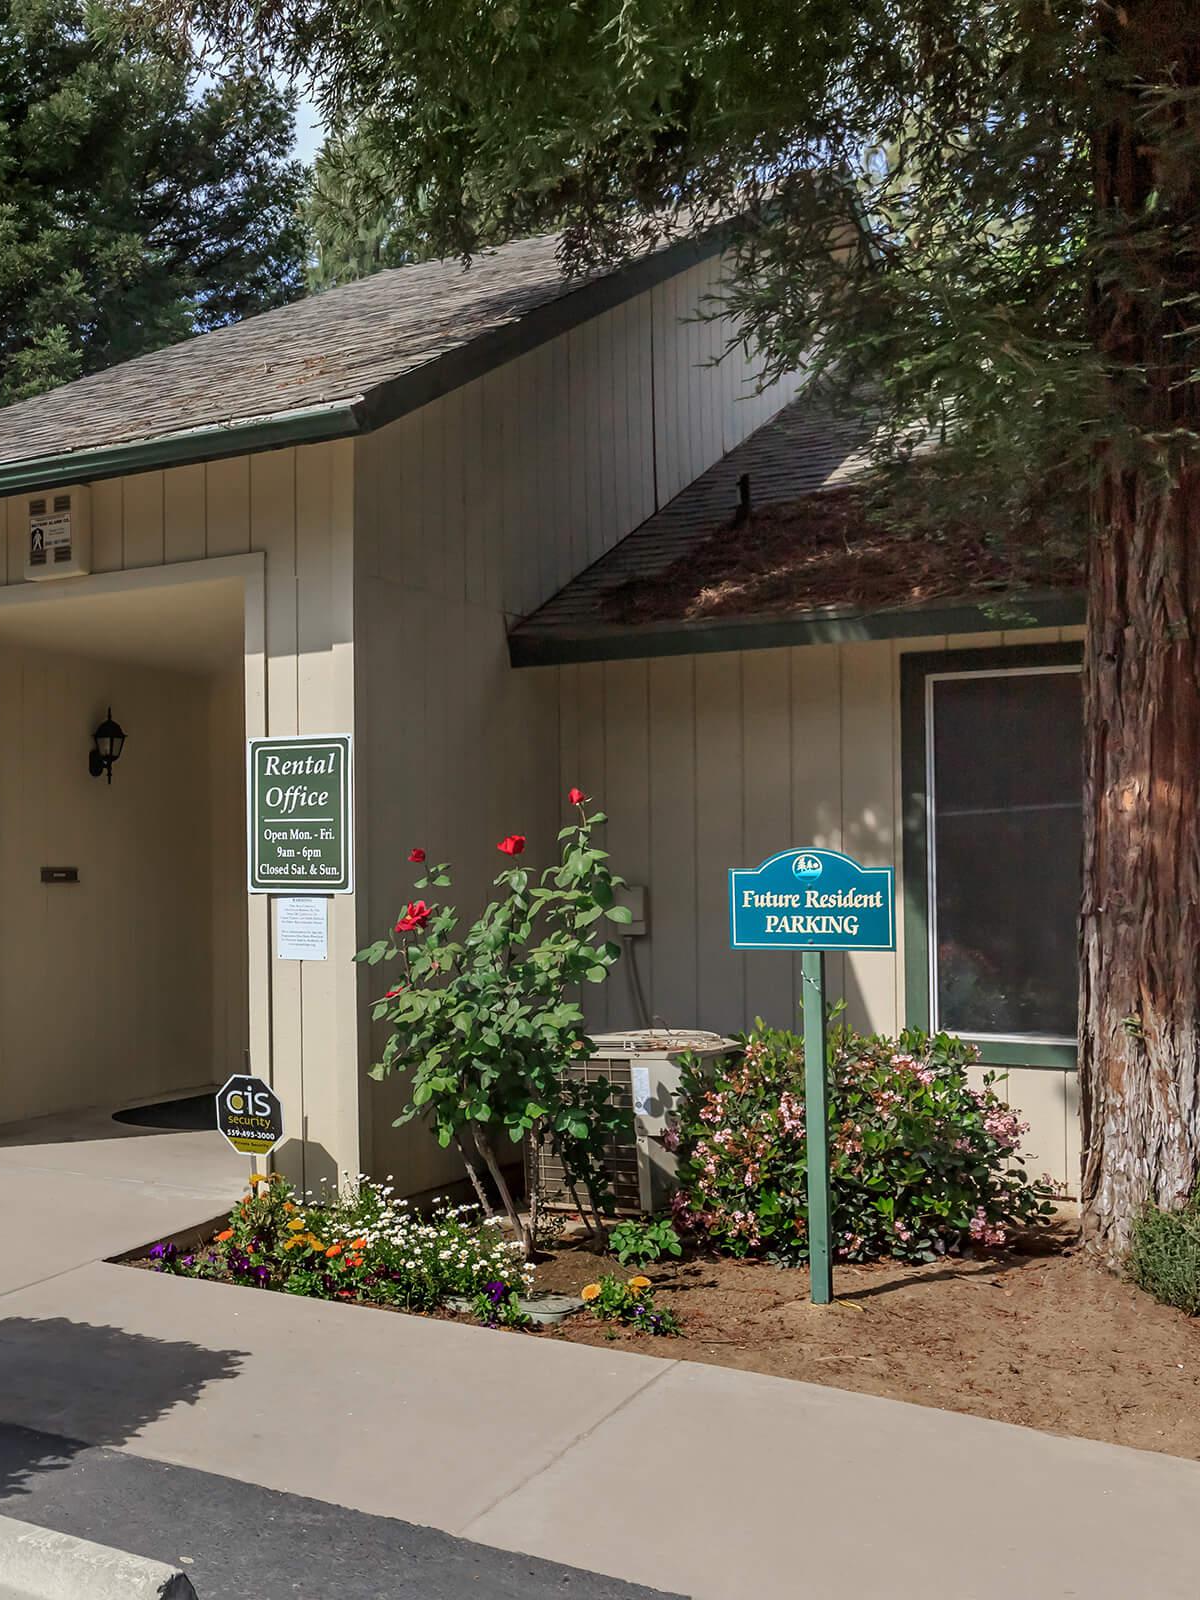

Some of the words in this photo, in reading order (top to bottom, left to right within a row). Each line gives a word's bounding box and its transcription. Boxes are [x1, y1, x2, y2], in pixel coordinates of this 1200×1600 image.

[264, 752, 336, 776] Rental
[266, 785, 329, 814] Office
[264, 829, 288, 843] Open
[290, 828, 312, 840] Mon.
[320, 827, 335, 840] Fri.
[277, 847, 295, 858] 9am
[302, 846, 321, 860] 6pm
[259, 864, 289, 875] Closed
[291, 864, 308, 875] Sat.
[309, 864, 318, 875] &
[319, 863, 339, 875] Sun.
[742, 890, 801, 908] Future
[805, 888, 883, 909] Resident
[765, 915, 860, 936] PARKING
[228, 1115, 271, 1129] security
[227, 1129, 275, 1140] 559-495-3000
